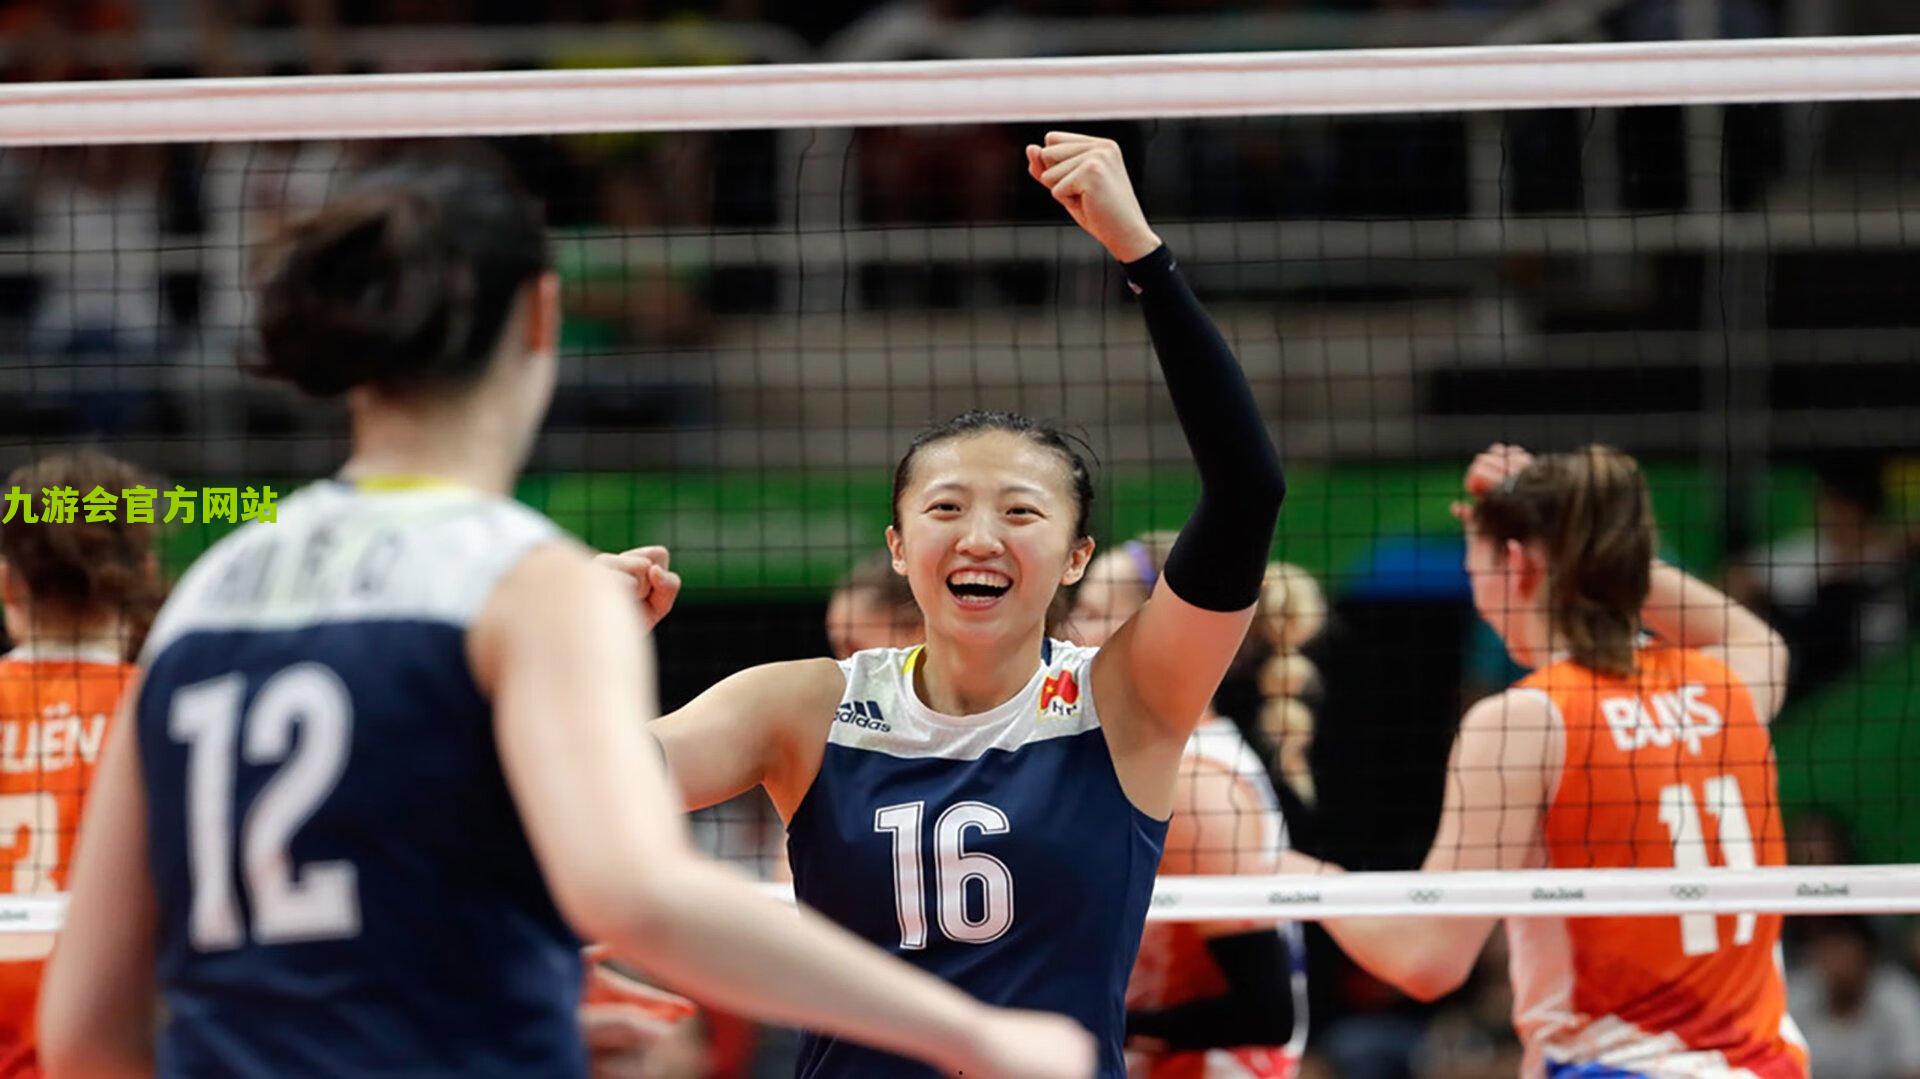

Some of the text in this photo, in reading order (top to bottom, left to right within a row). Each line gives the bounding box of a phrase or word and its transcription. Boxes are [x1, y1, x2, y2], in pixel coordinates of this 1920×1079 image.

[167, 660, 362, 952] 12
[874, 800, 1014, 950] 16
[1658, 774, 1757, 956] 11
